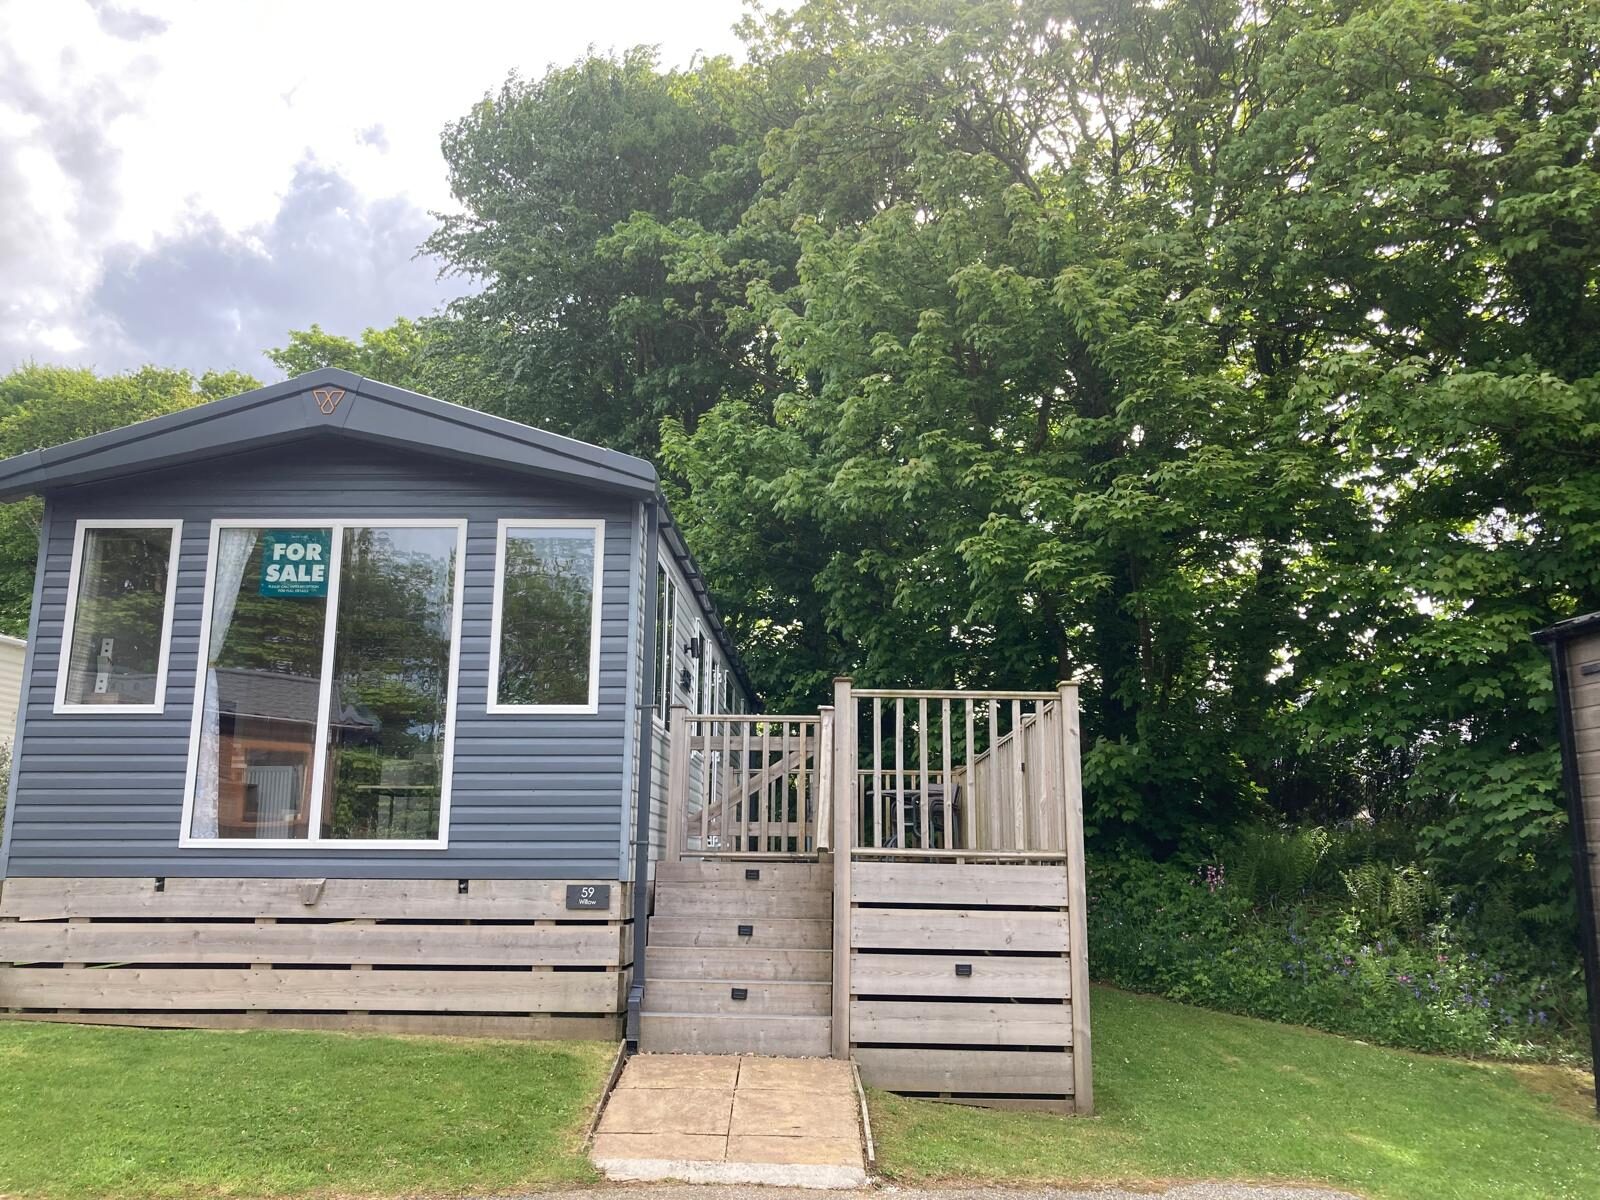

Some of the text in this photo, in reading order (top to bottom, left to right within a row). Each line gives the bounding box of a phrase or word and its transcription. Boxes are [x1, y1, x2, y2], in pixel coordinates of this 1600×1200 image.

[273, 543, 322, 561] FOR
[265, 564, 325, 582] SALE
[581, 887, 595, 898] 59
